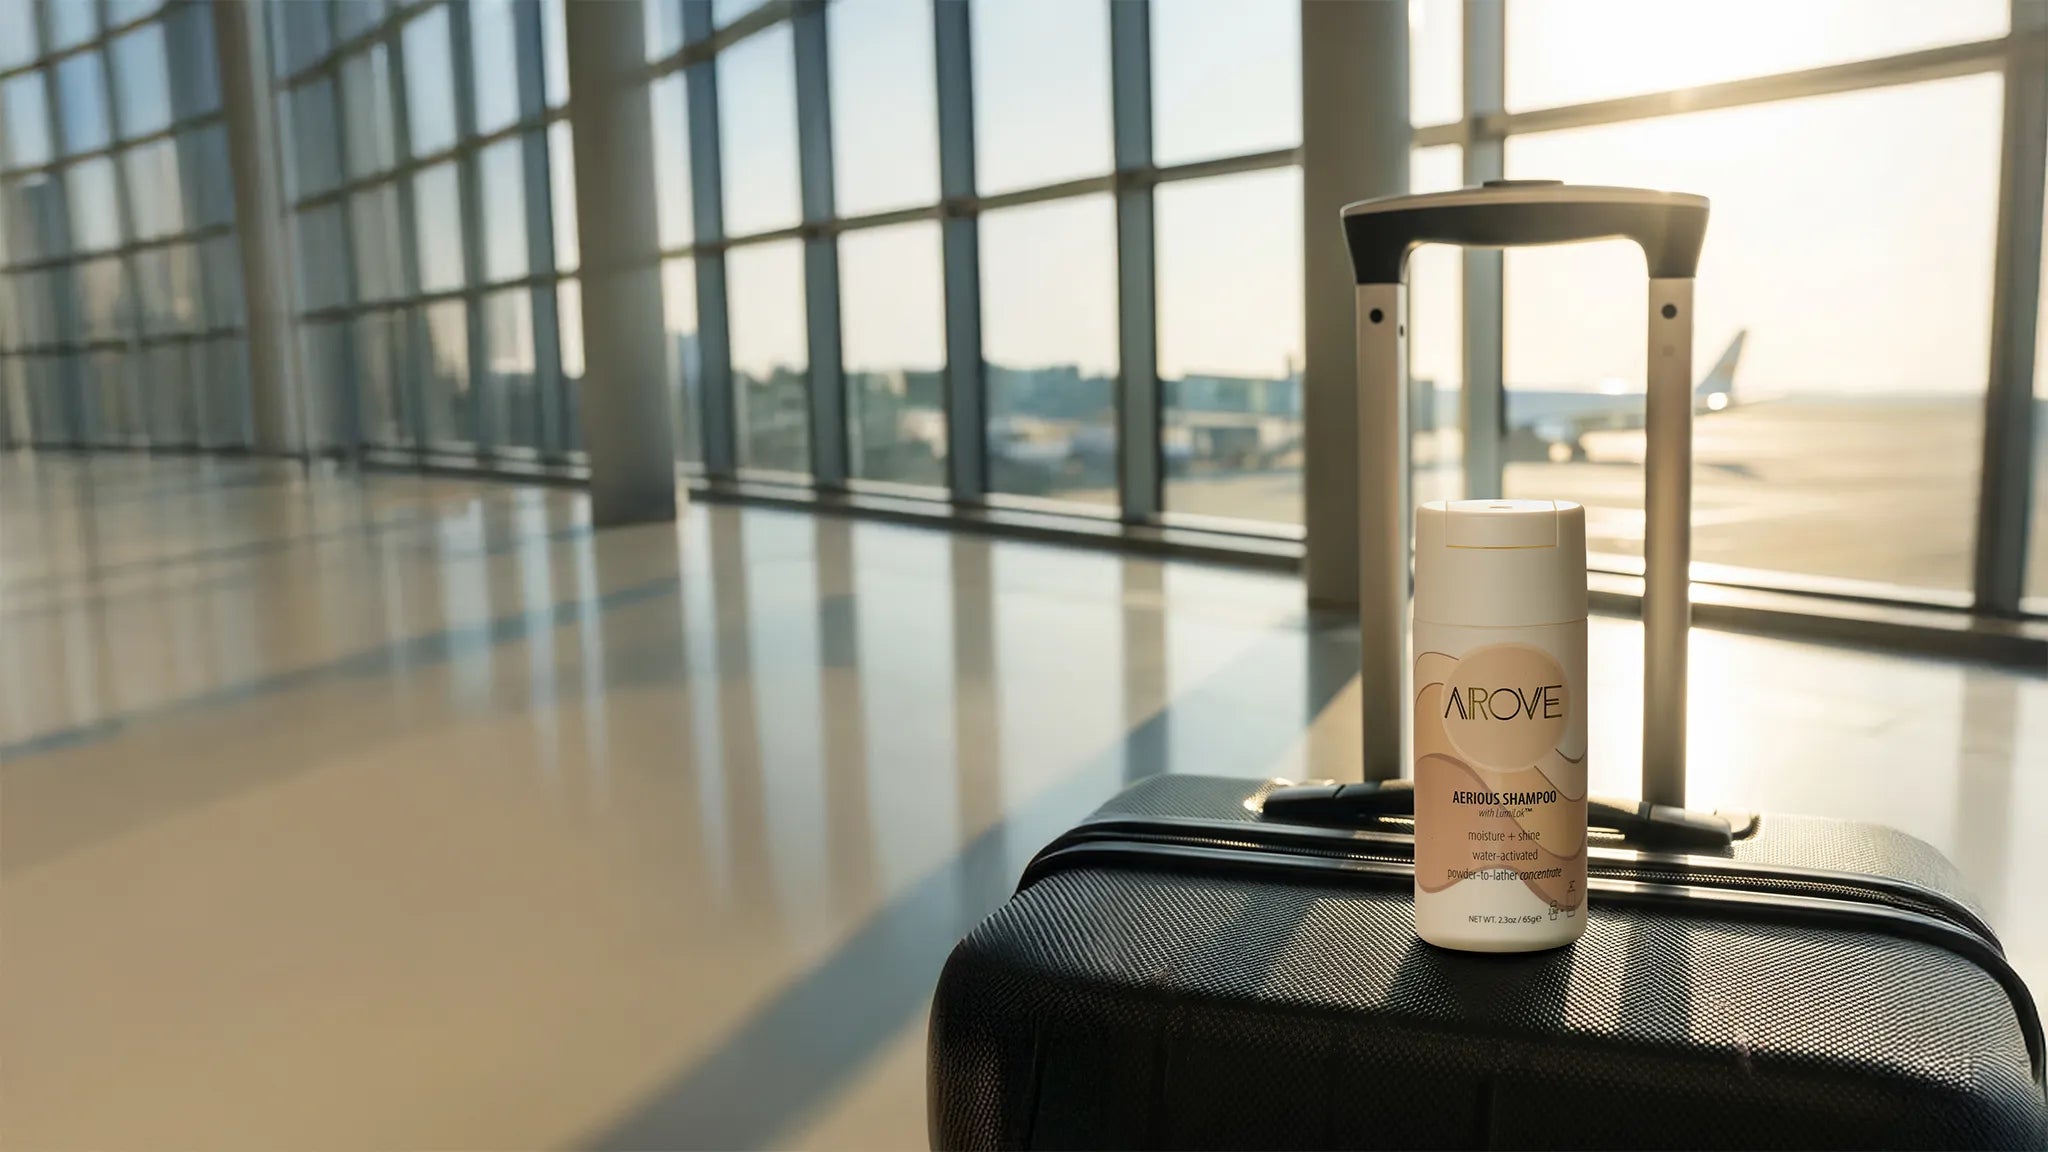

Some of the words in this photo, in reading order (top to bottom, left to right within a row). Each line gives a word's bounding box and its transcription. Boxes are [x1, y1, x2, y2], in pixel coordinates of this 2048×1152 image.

[1452, 791, 1500, 805] AERIOUS
[1503, 790, 1557, 805] SHAMPOO
[1478, 808, 1495, 817] with
[1468, 830, 1505, 841] moisture
[1518, 830, 1540, 841] shine
[1472, 849, 1538, 861] water-activated
[1447, 868, 1518, 881] powder-to-lather
[1519, 867, 1562, 881] concentrate
[1468, 915, 1482, 923] NET
[1483, 915, 1496, 924] WT.
[1498, 916, 1517, 924] 2.3oz
